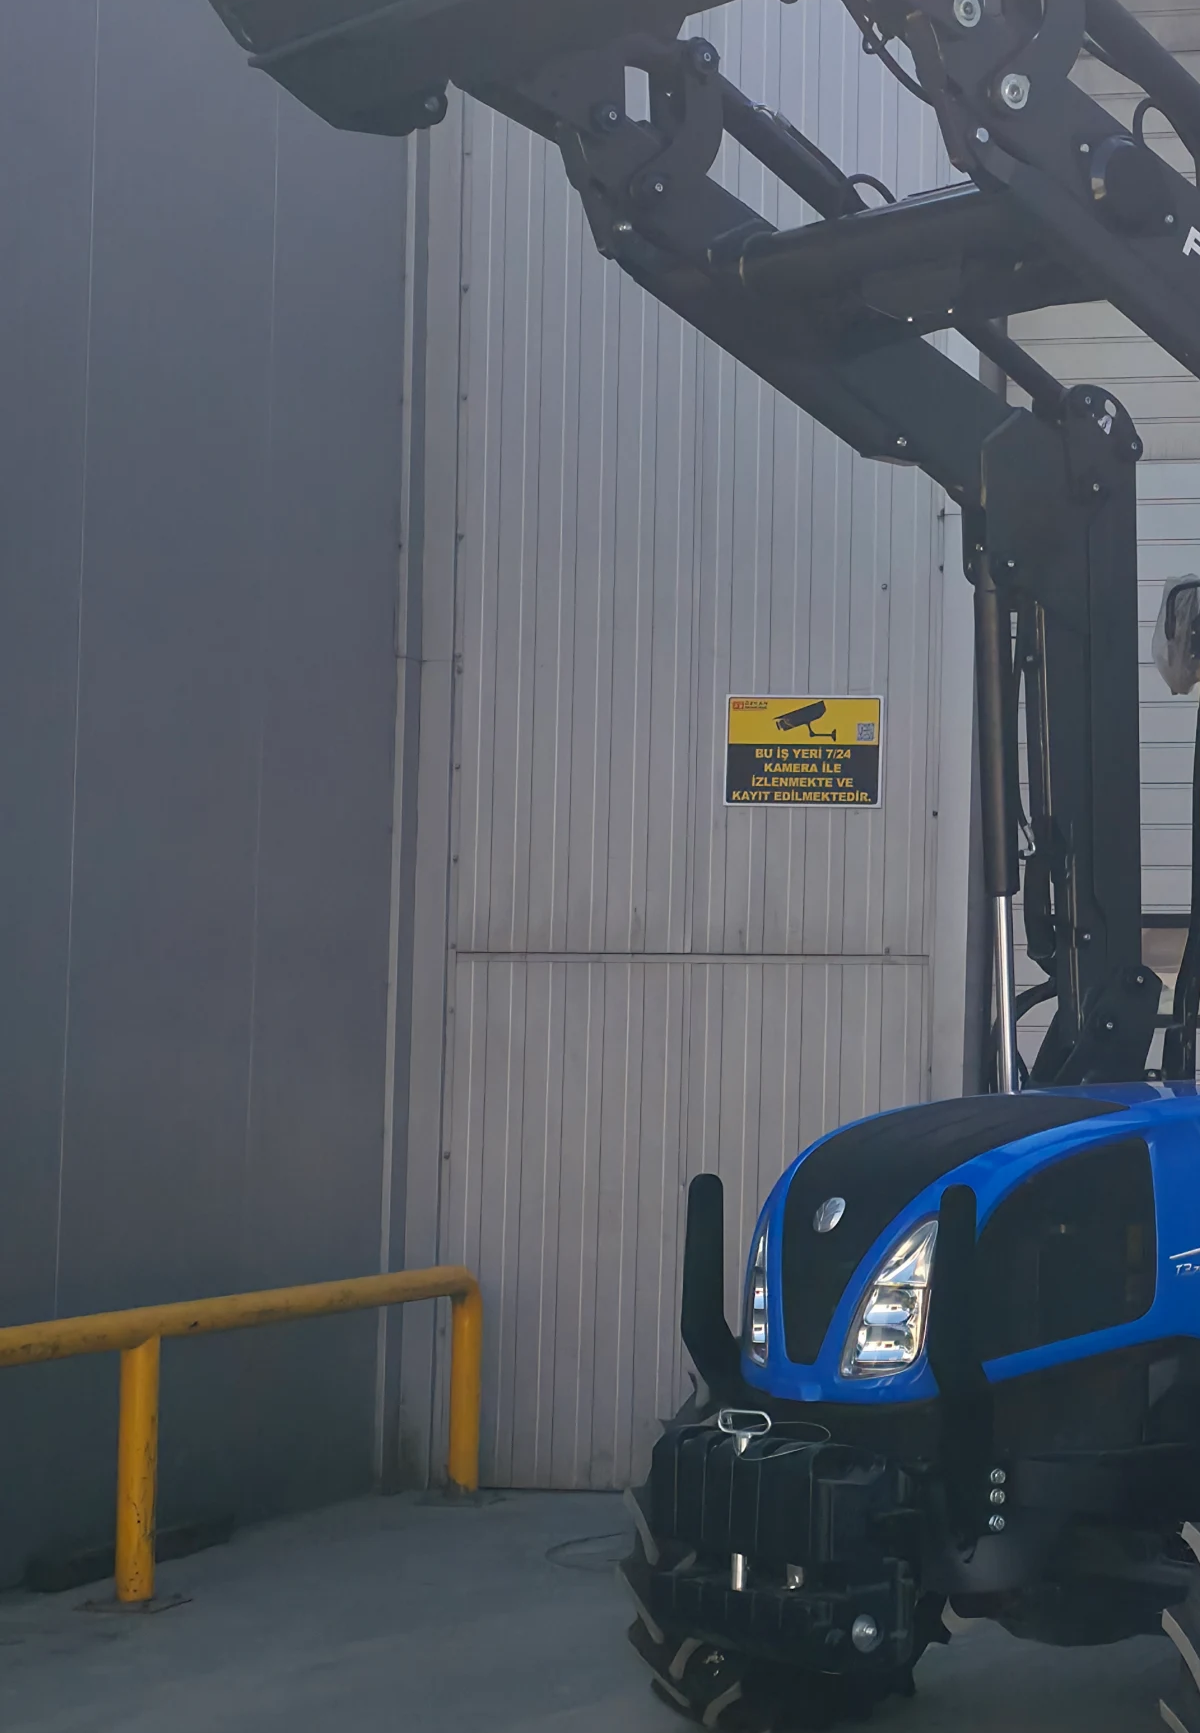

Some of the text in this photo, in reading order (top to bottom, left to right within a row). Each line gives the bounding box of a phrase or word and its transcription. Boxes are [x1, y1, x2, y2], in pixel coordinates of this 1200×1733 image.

[755, 747, 851, 761] BU İŞ YERİ 7/24
[764, 761, 842, 773] KAMERA İLE
[751, 774, 853, 787] İZLENMEKTE VE
[732, 789, 872, 802] KAYIT EDİLMEKTEDİR.
